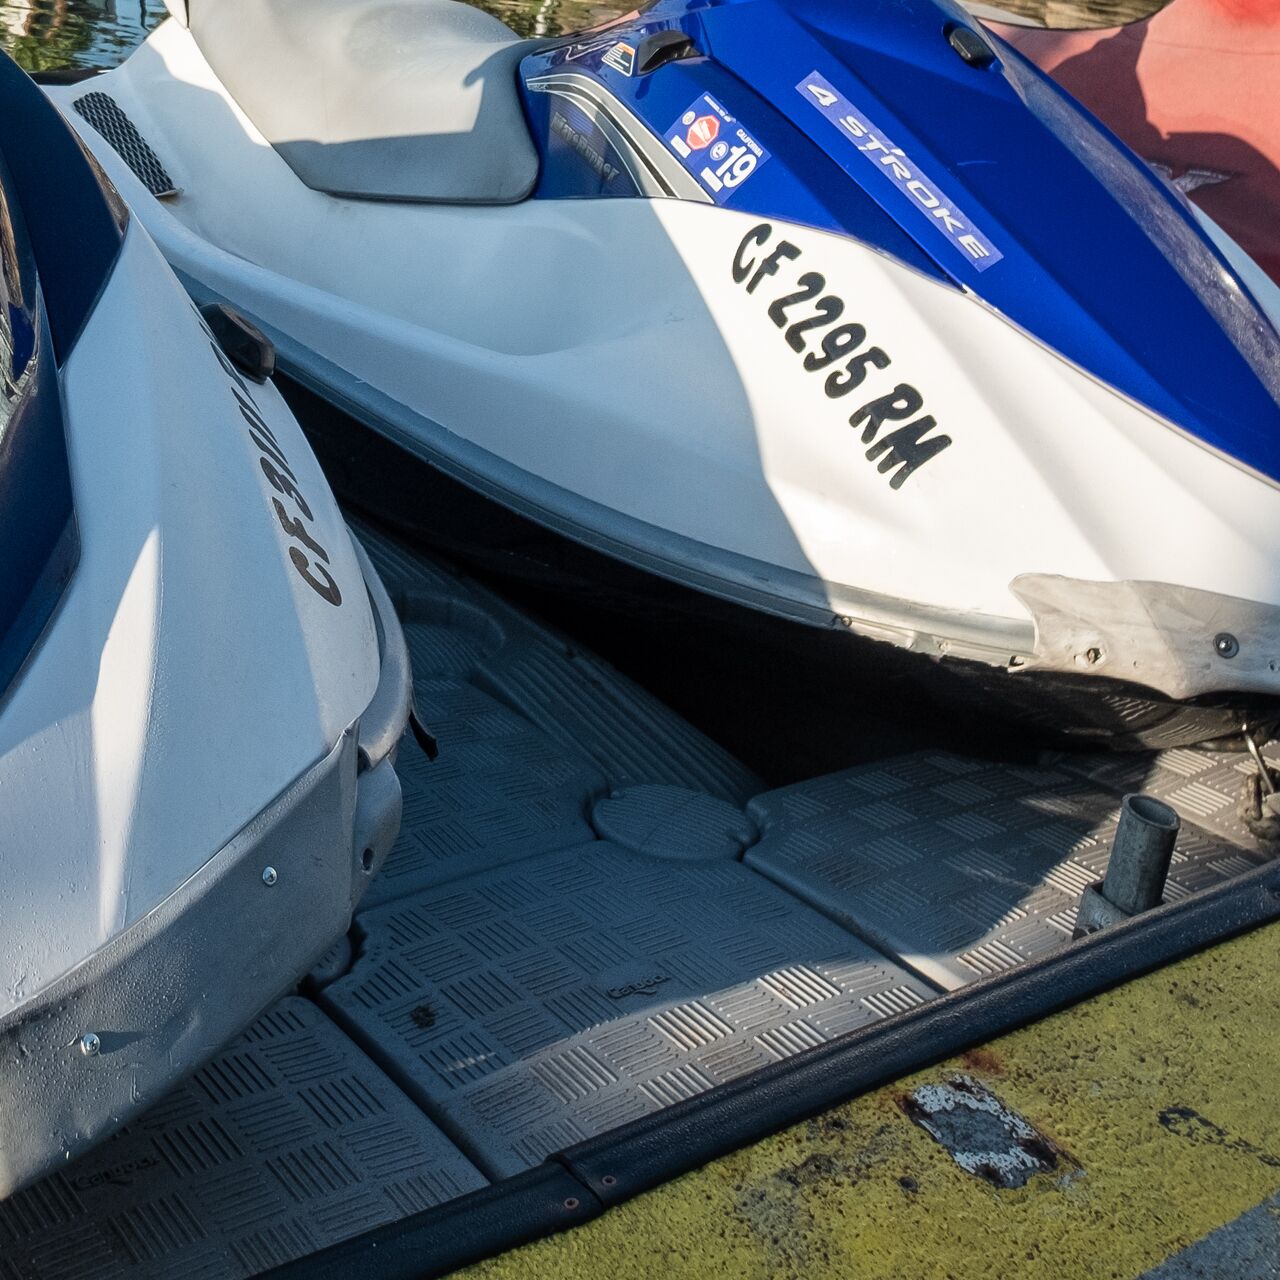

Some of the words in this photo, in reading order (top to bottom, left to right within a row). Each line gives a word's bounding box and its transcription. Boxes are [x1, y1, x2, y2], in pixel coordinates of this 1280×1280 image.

[715, 145, 757, 188] 19
[807, 83, 837, 107] 4
[839, 114, 990, 259] STROKE
[732, 223, 802, 295] CF
[767, 271, 891, 399] 2295
[848, 382, 952, 490] RM
